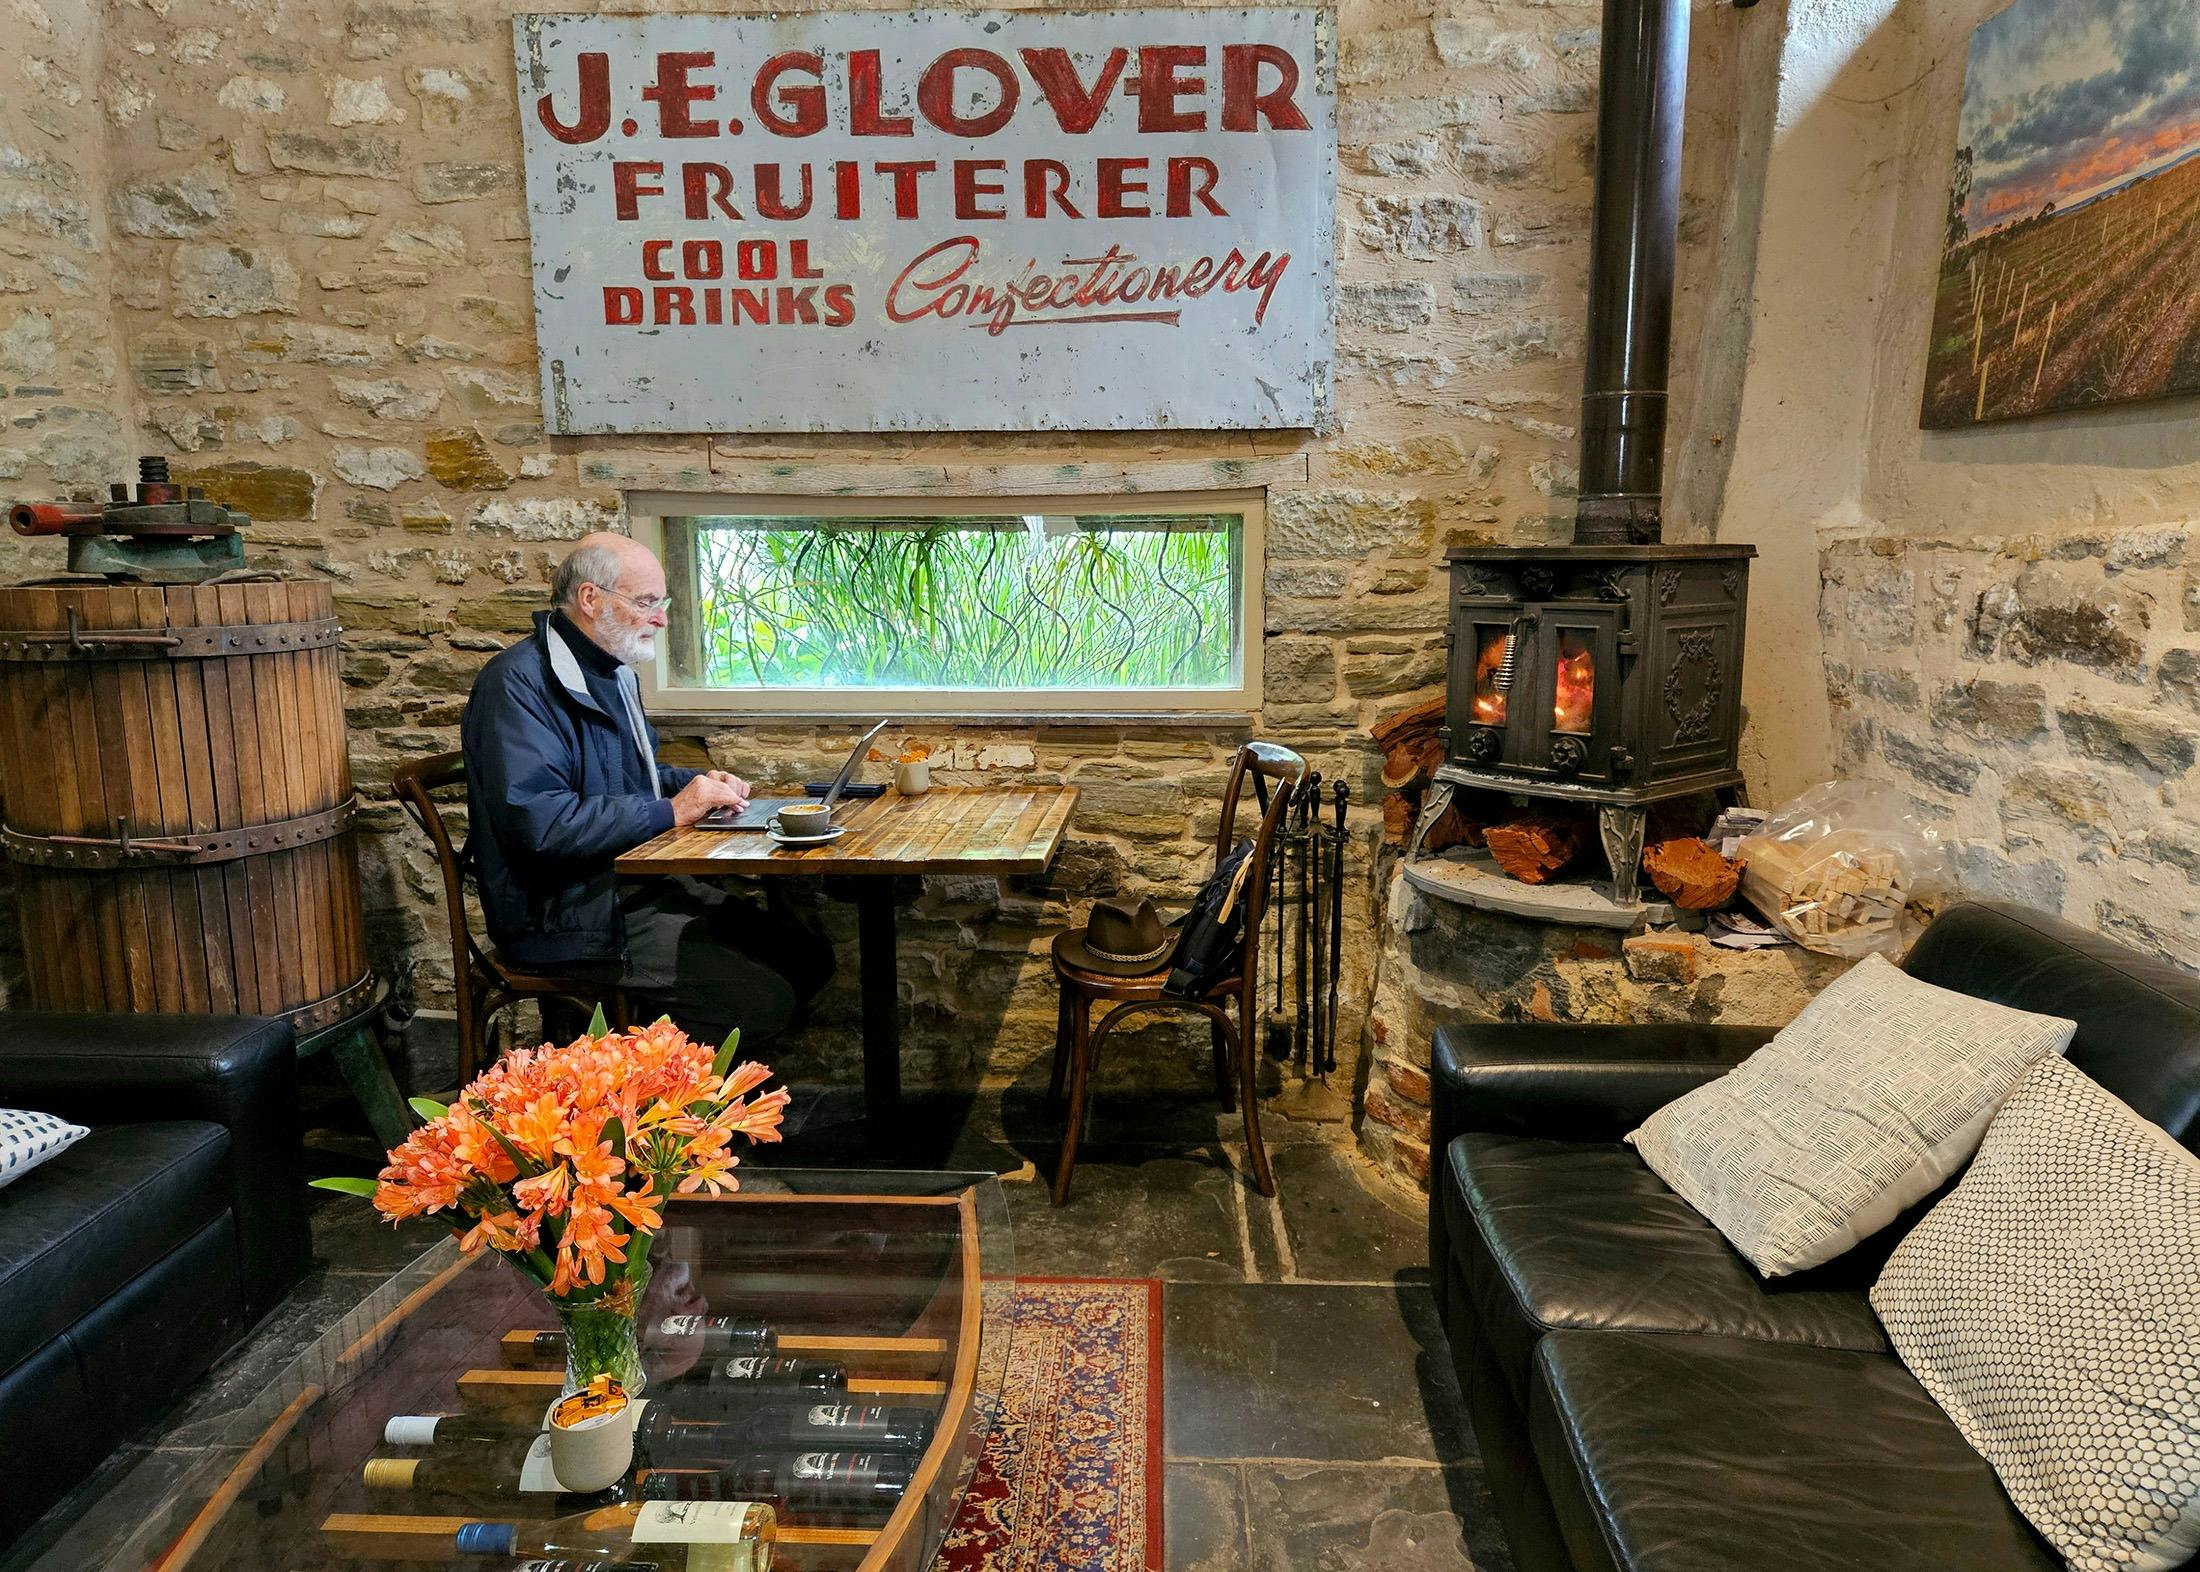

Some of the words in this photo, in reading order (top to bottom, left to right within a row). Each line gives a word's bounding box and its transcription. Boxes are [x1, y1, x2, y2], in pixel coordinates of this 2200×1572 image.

[613, 157, 1230, 221] FRUITERER
[642, 239, 824, 281] COOL
[885, 235, 1291, 336] Confectionery
[603, 284, 855, 327] DRINKS
